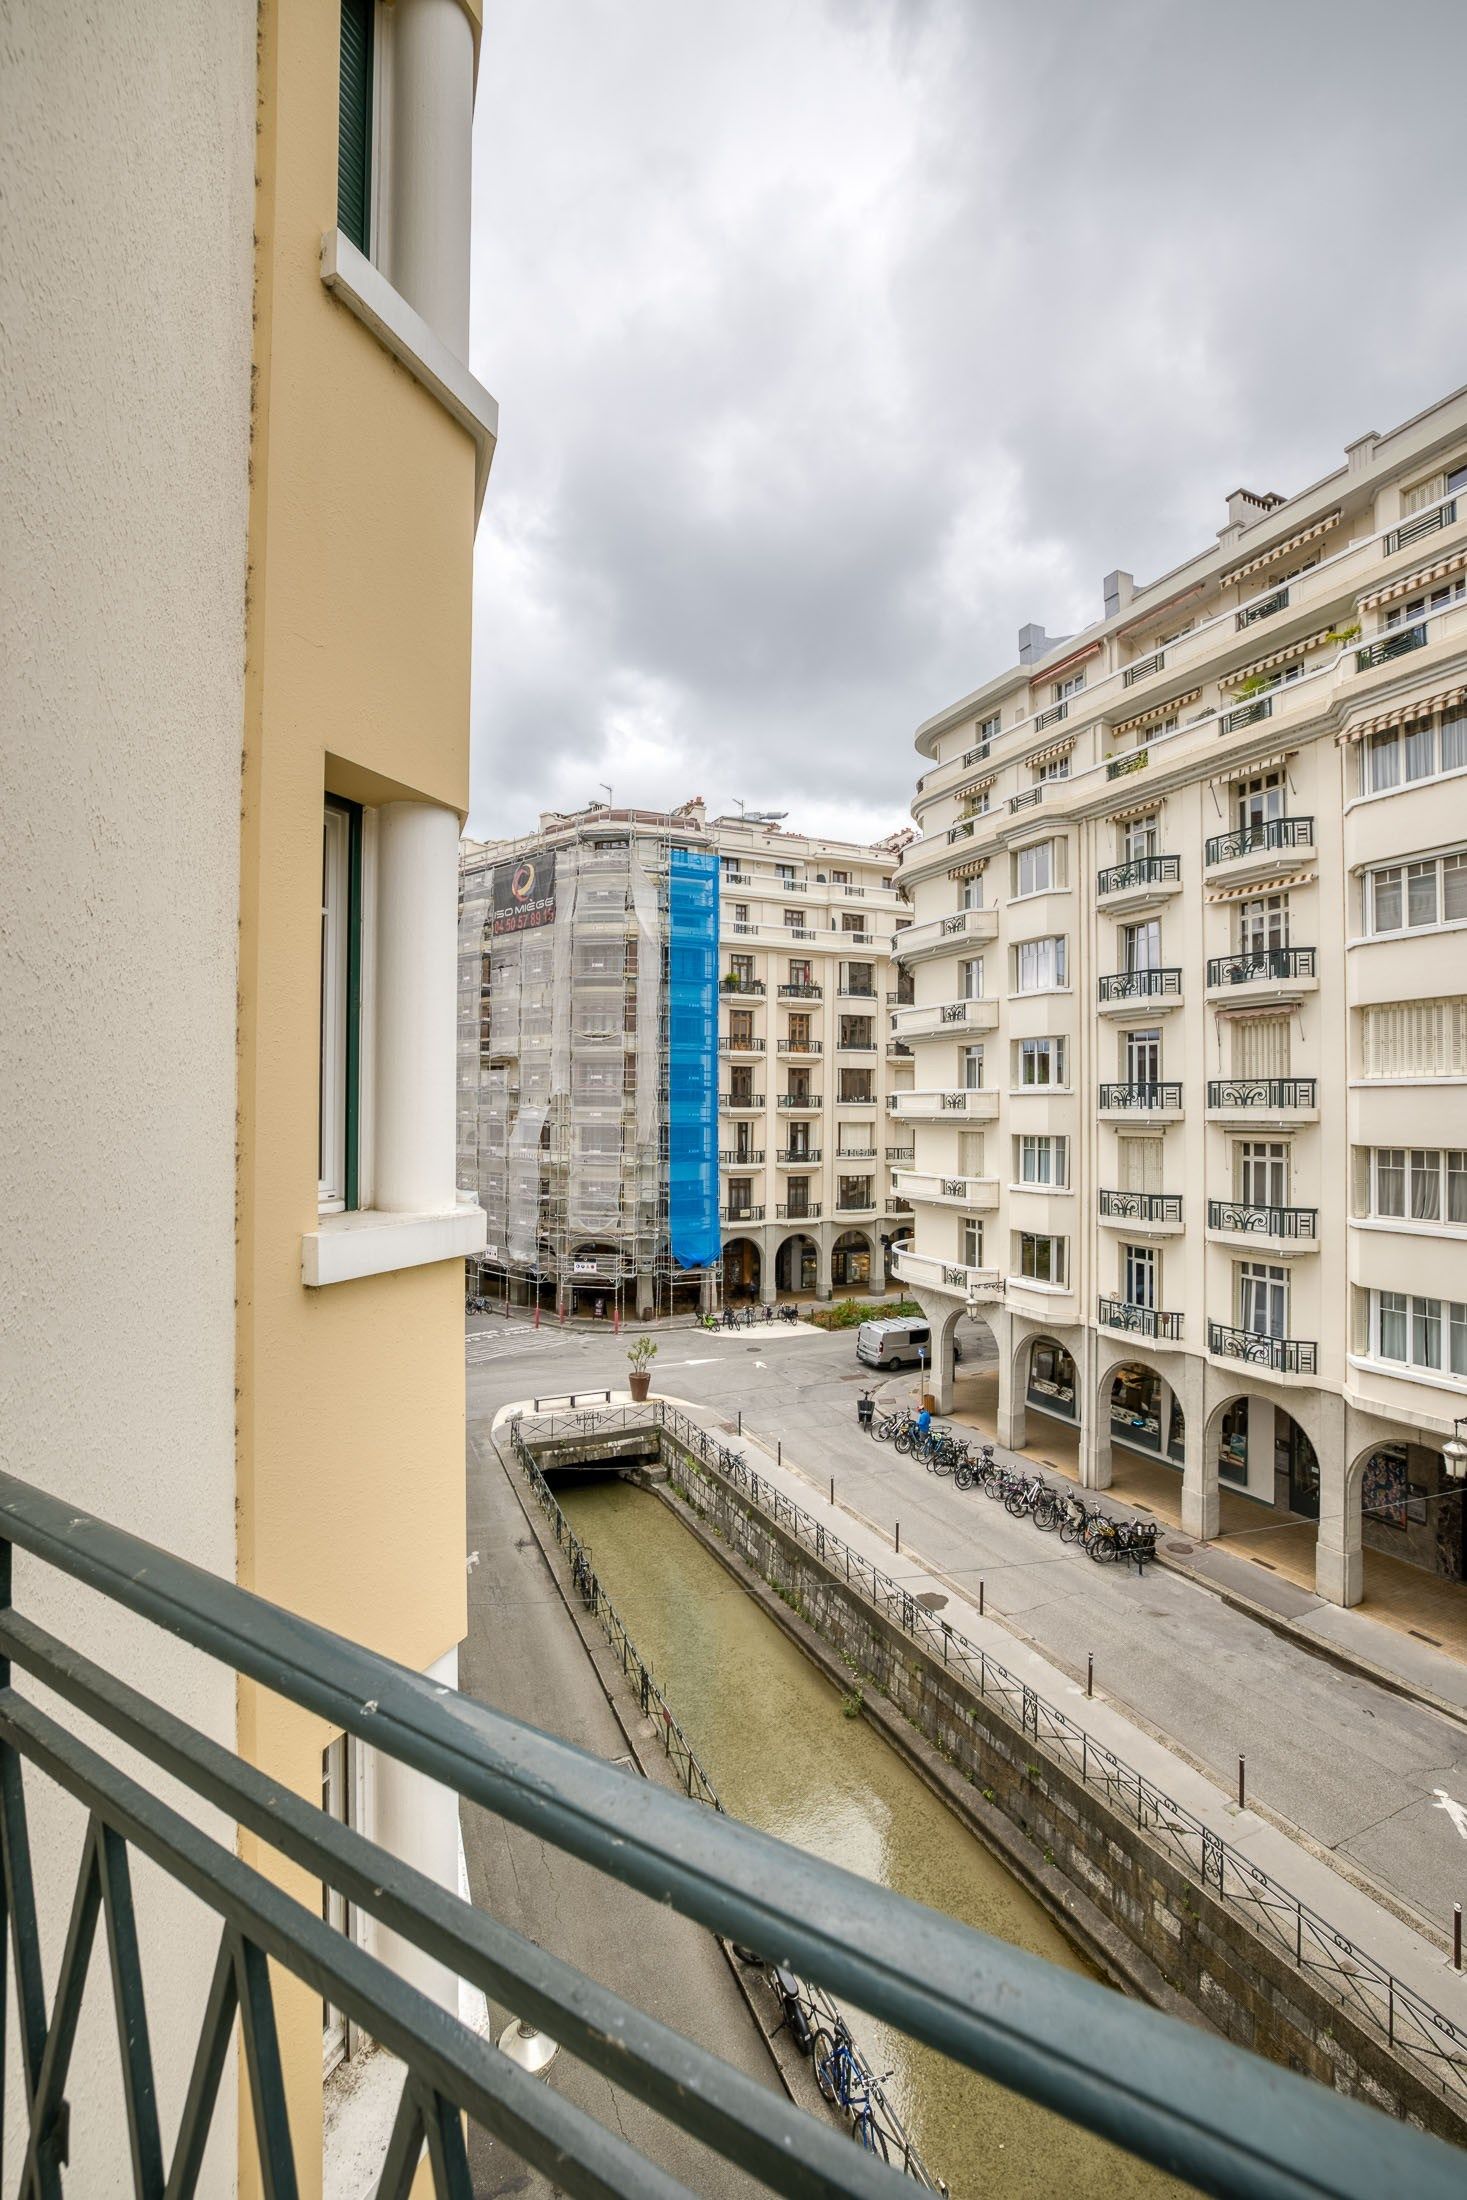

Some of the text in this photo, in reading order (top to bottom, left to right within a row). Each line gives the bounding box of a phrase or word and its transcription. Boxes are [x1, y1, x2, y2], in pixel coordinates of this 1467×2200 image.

[515, 897, 553, 914] MIÈGE
[506, 917, 516, 930] 50
[518, 914, 528, 928] 57
[530, 911, 540, 926] 89
